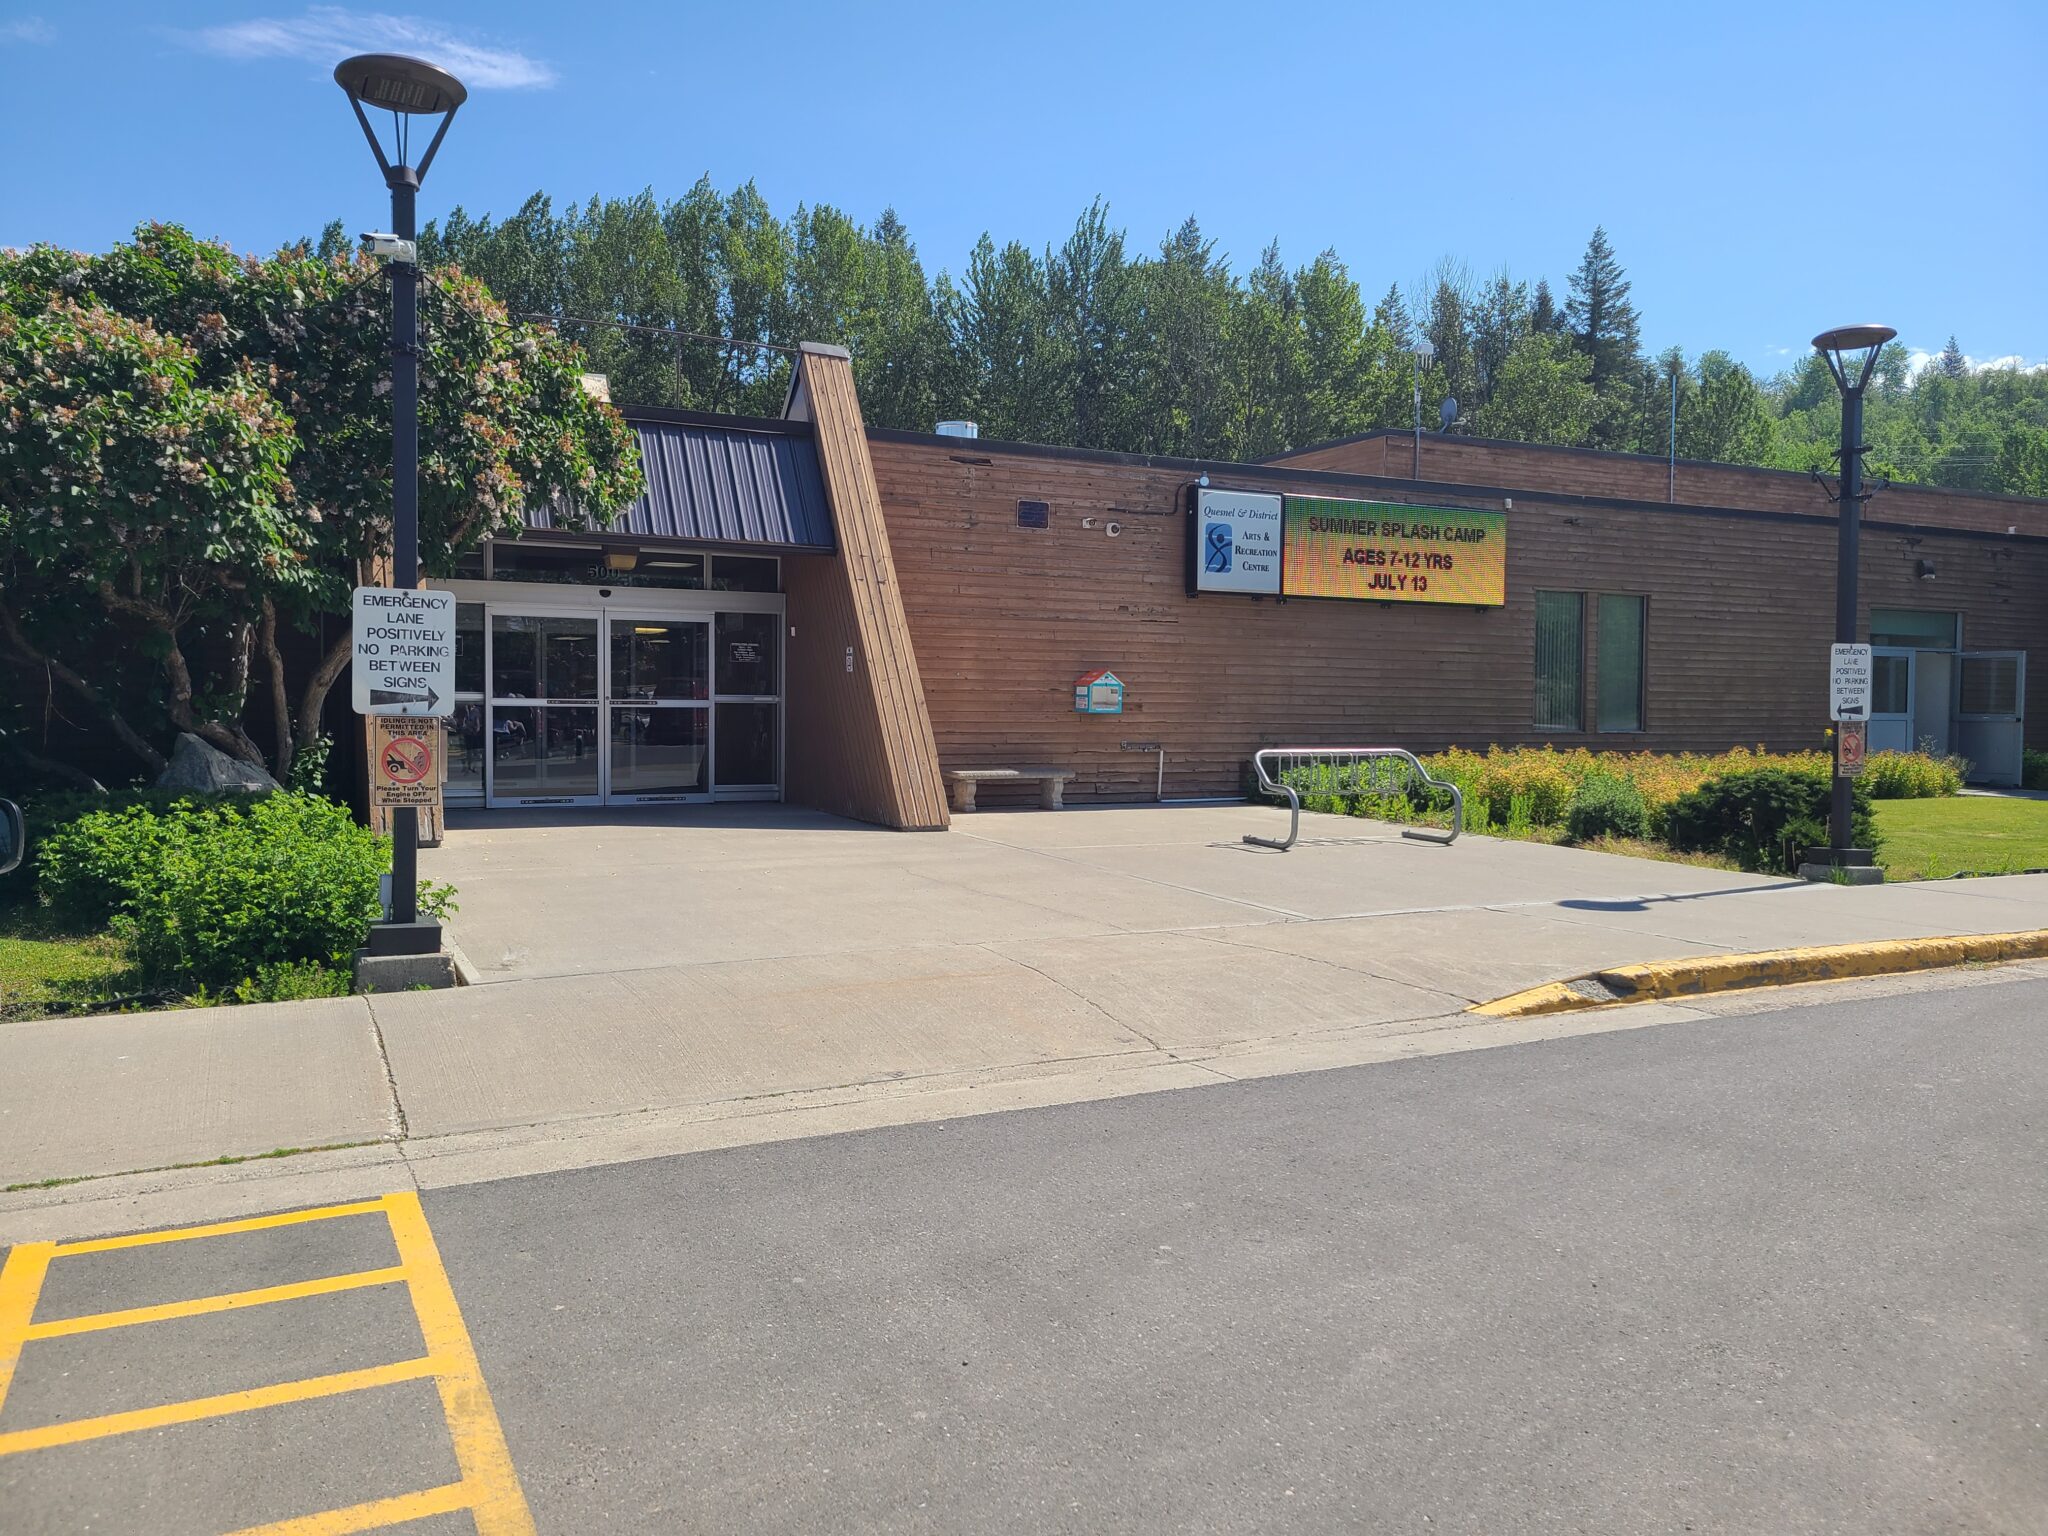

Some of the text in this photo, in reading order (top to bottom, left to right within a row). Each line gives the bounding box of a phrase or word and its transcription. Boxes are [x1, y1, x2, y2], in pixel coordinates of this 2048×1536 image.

[1204, 506, 1278, 520] Quesnel & District
[1264, 532, 1270, 541] &
[1309, 517, 1485, 543] SUMMER SPLASH CAMP
[1343, 548, 1453, 570] AGES 7-12 YRS
[1368, 574, 1427, 592] JULY 13
[363, 595, 448, 610] EMERGENCY
[387, 613, 424, 624] LANE
[367, 628, 446, 641] POSITIVELY
[358, 644, 379, 655] NO
[390, 645, 449, 657] PARKING
[369, 660, 440, 673] BETWEEN
[384, 677, 427, 688] SIGNS
